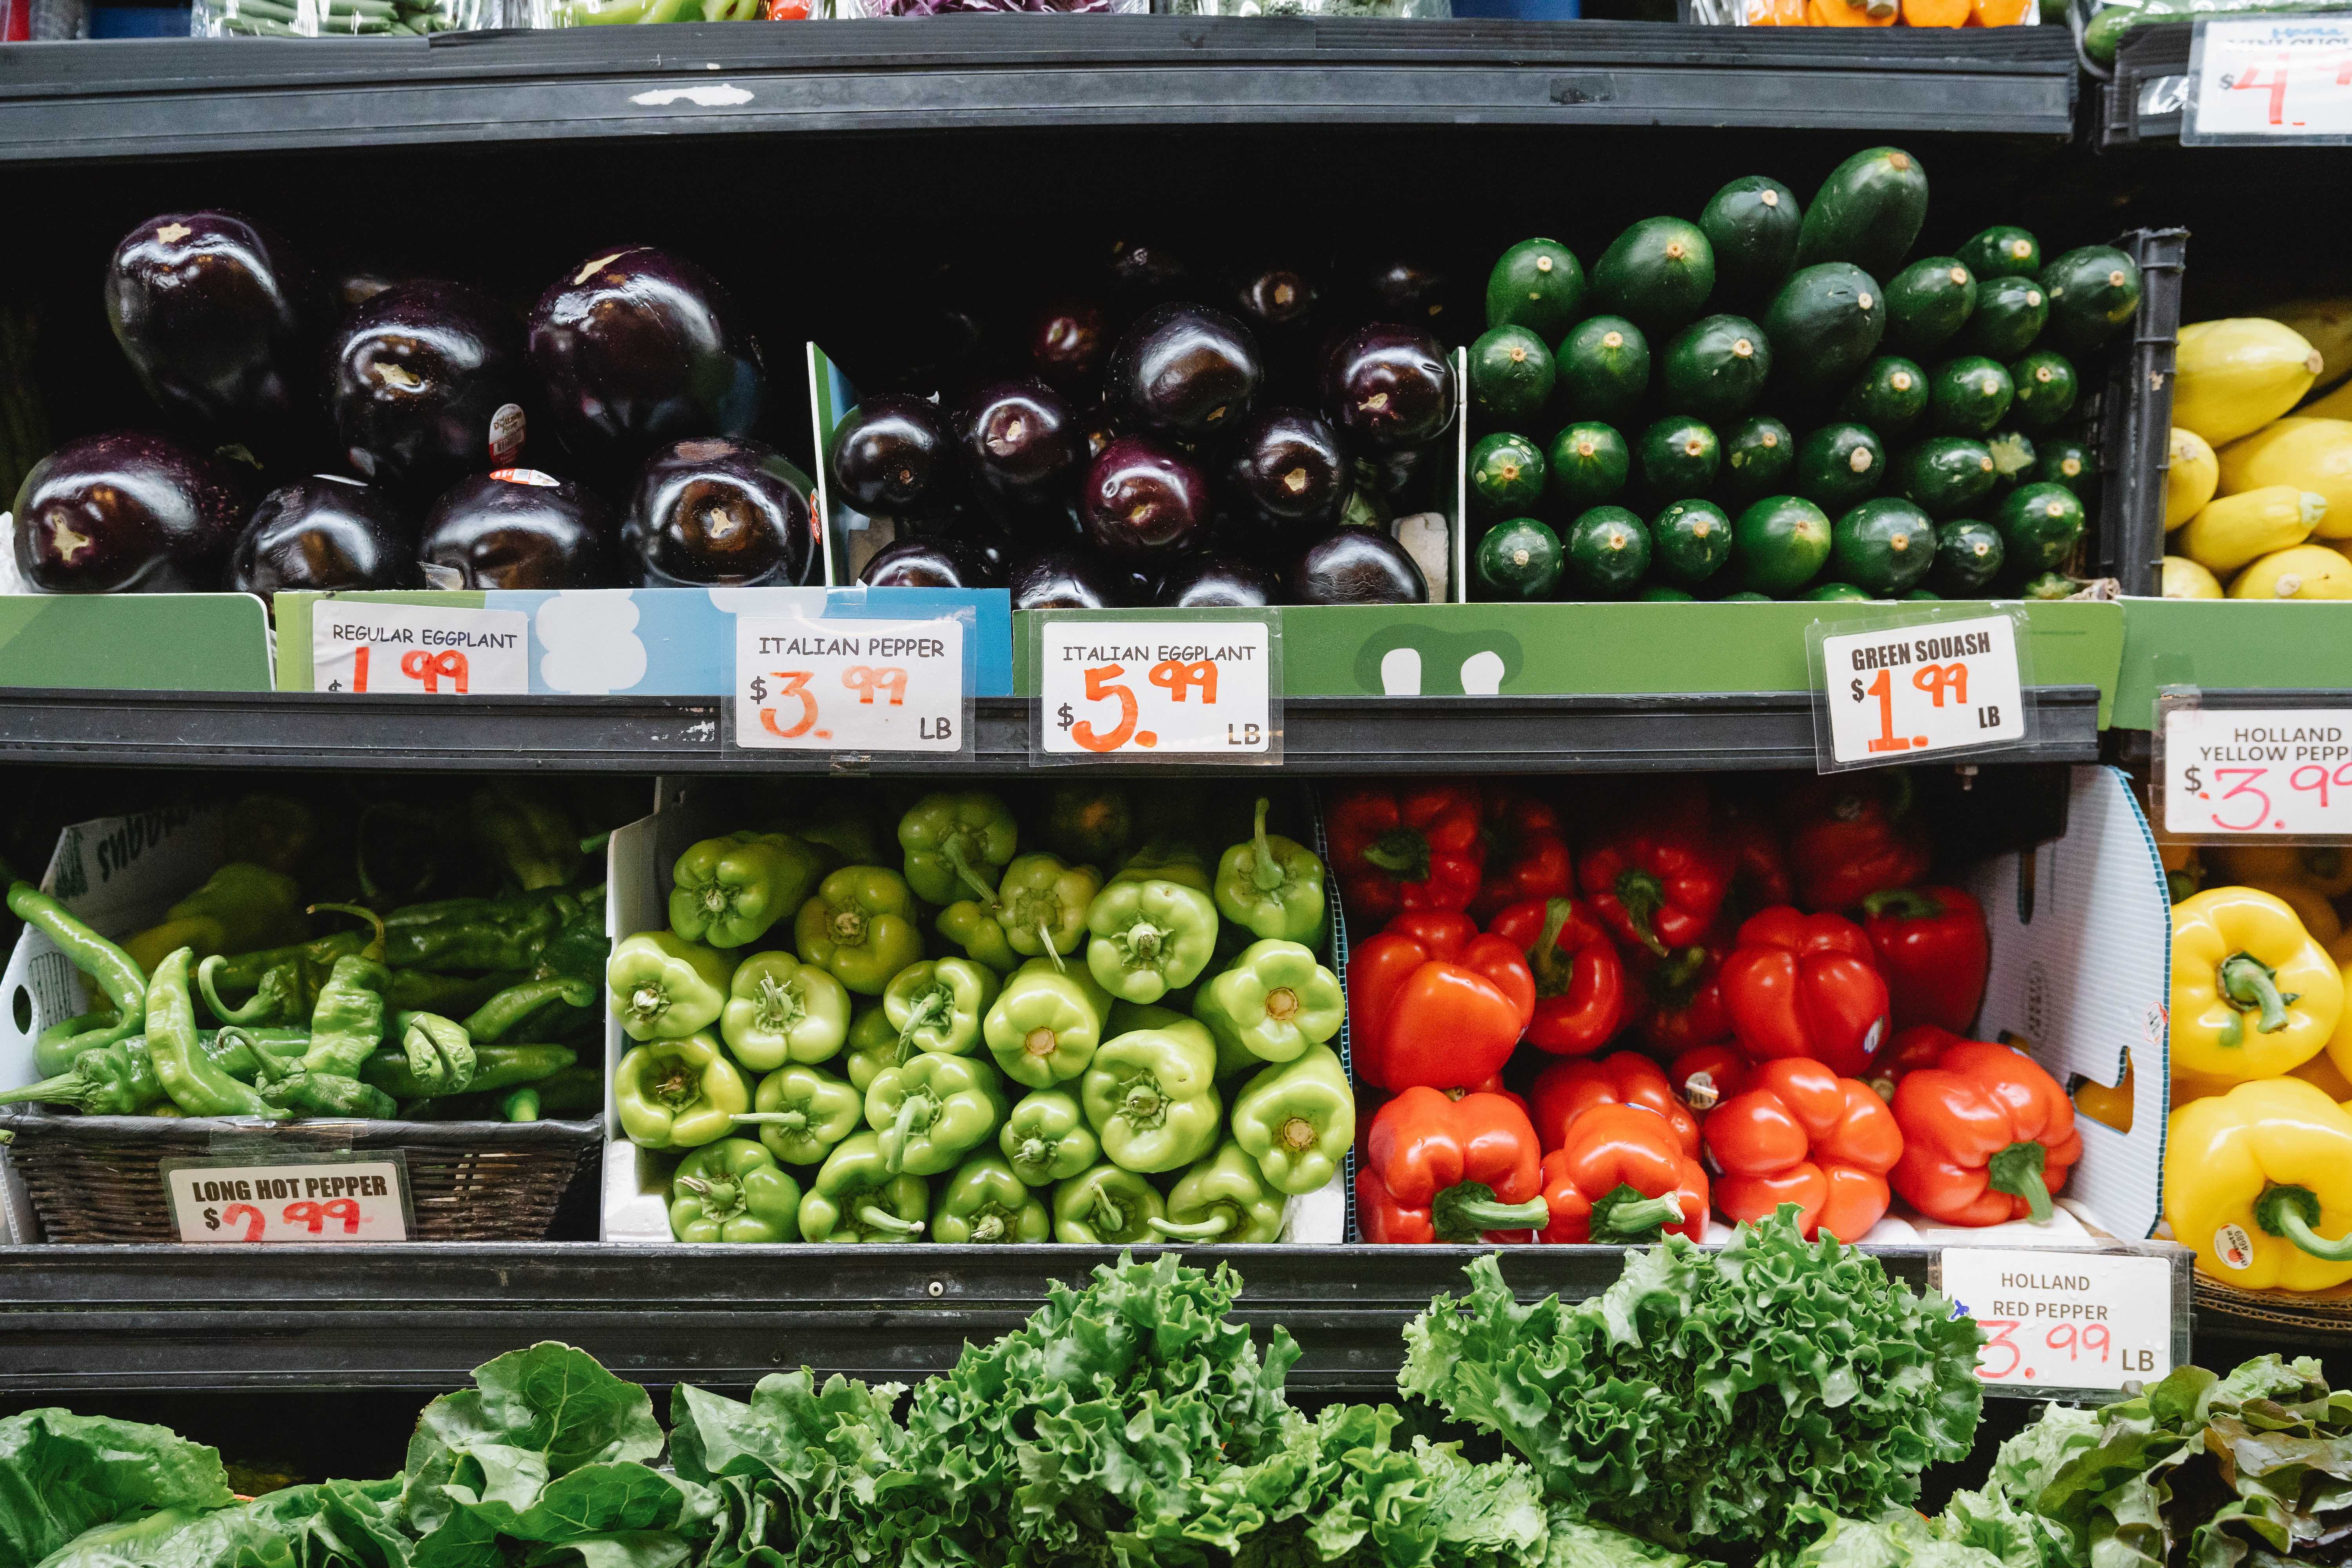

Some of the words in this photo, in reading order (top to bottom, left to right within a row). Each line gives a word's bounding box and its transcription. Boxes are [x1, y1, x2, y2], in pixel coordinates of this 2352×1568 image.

[333, 624, 414, 644] REGULAR
[422, 629, 517, 648] EGGPLANT
[759, 637, 860, 655] ITALIAN
[868, 638, 944, 658] PEPPER
[1063, 646, 1149, 661] ITALIAN
[1158, 645, 1256, 662] EGGPLANT
[1851, 642, 1911, 671] GREEN
[1915, 632, 1991, 662] SQUASH
[1978, 706, 2000, 728] LB
[920, 717, 952, 740] LB
[1227, 722, 1261, 745] LB
[2234, 728, 2342, 742] HOLLAND
[2200, 747, 2288, 761] YELLOW
[2296, 747, 2352, 760] PEPP
[192, 1180, 252, 1202] LONG
[255, 1178, 299, 1200] HOT
[306, 1175, 388, 1198] PEPPER
[2002, 1272, 2090, 1291] HOLLAND
[1993, 1300, 2030, 1316] RED
[2036, 1302, 2108, 1320] PEPPER
[2122, 1348, 2154, 1372] LB
